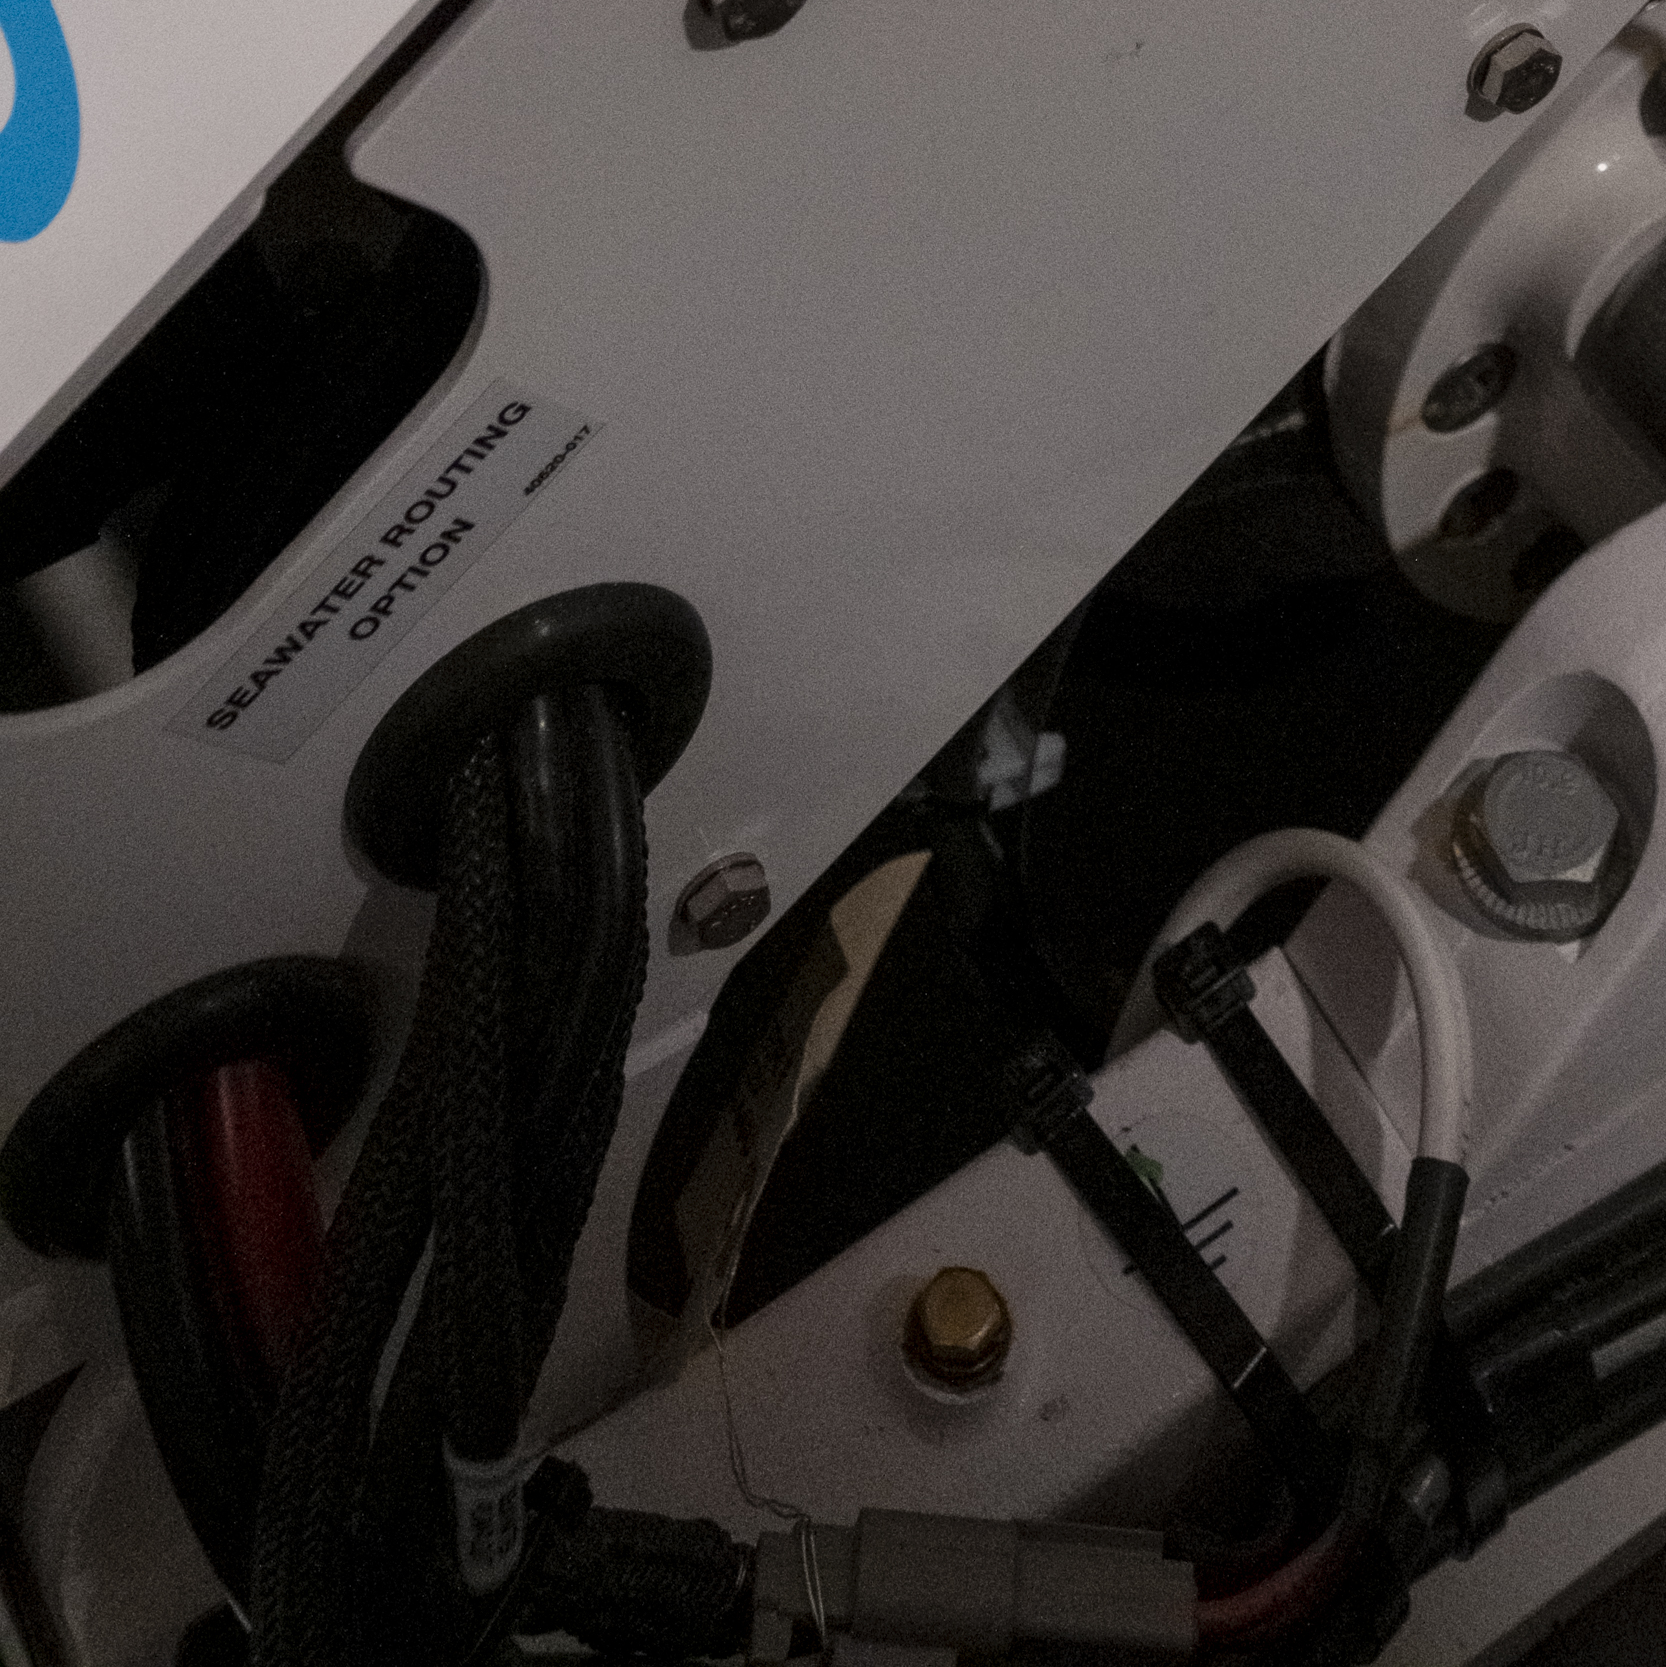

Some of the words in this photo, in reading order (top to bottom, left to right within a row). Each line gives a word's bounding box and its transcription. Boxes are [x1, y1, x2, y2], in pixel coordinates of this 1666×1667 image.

[206, 555, 386, 732] SEAWATER
[380, 401, 533, 549] ROUTING
[349, 517, 476, 641] OPTION
